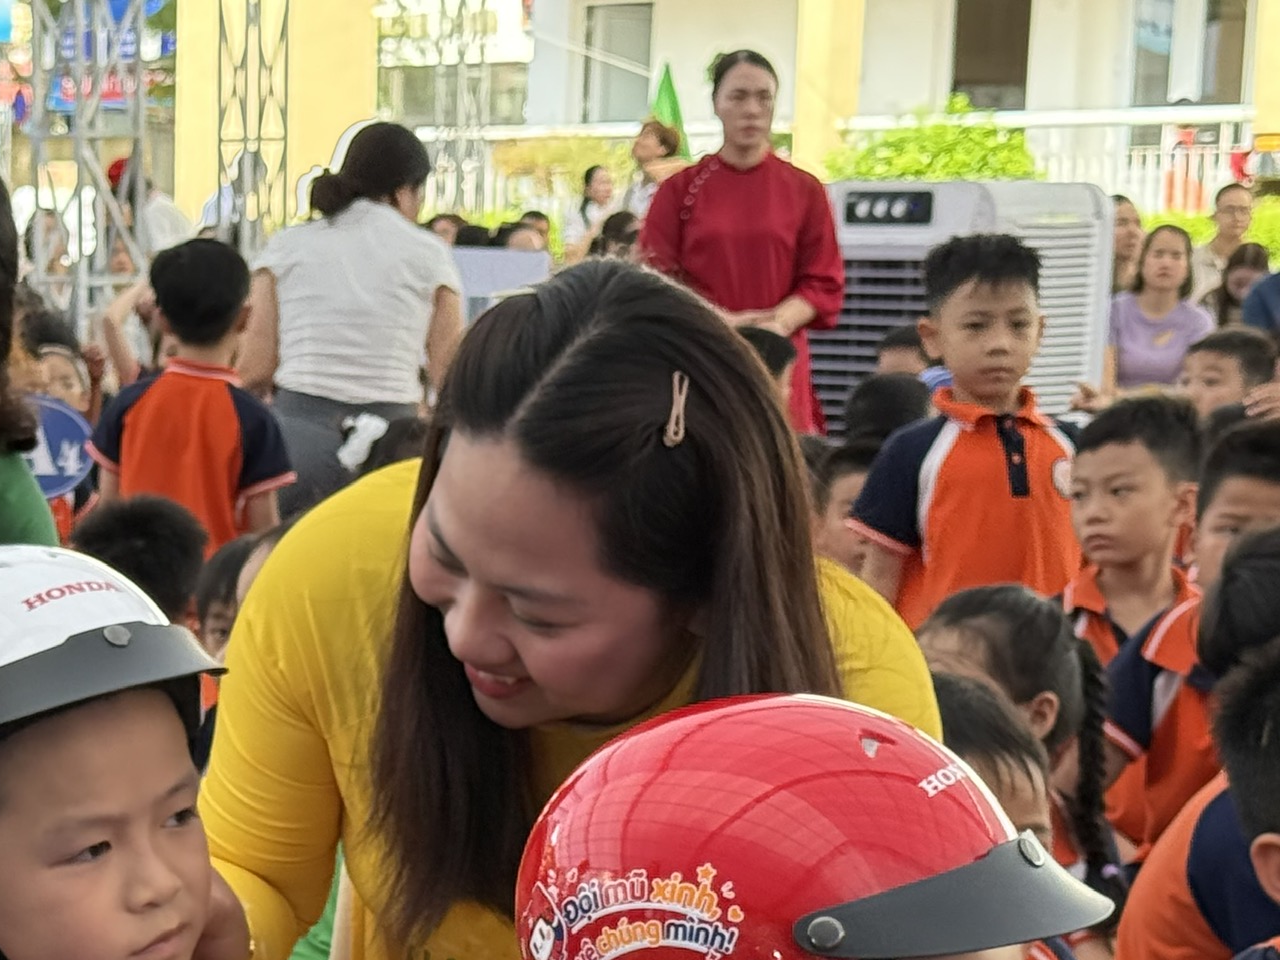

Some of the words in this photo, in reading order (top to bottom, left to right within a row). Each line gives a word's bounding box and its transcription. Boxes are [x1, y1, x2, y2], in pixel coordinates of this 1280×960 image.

[21, 581, 124, 612] HONDA
[602, 868, 648, 905] mũ
[651, 871, 721, 920] xinh,
[596, 917, 662, 957] chúng
[664, 917, 739, 954] mình!
